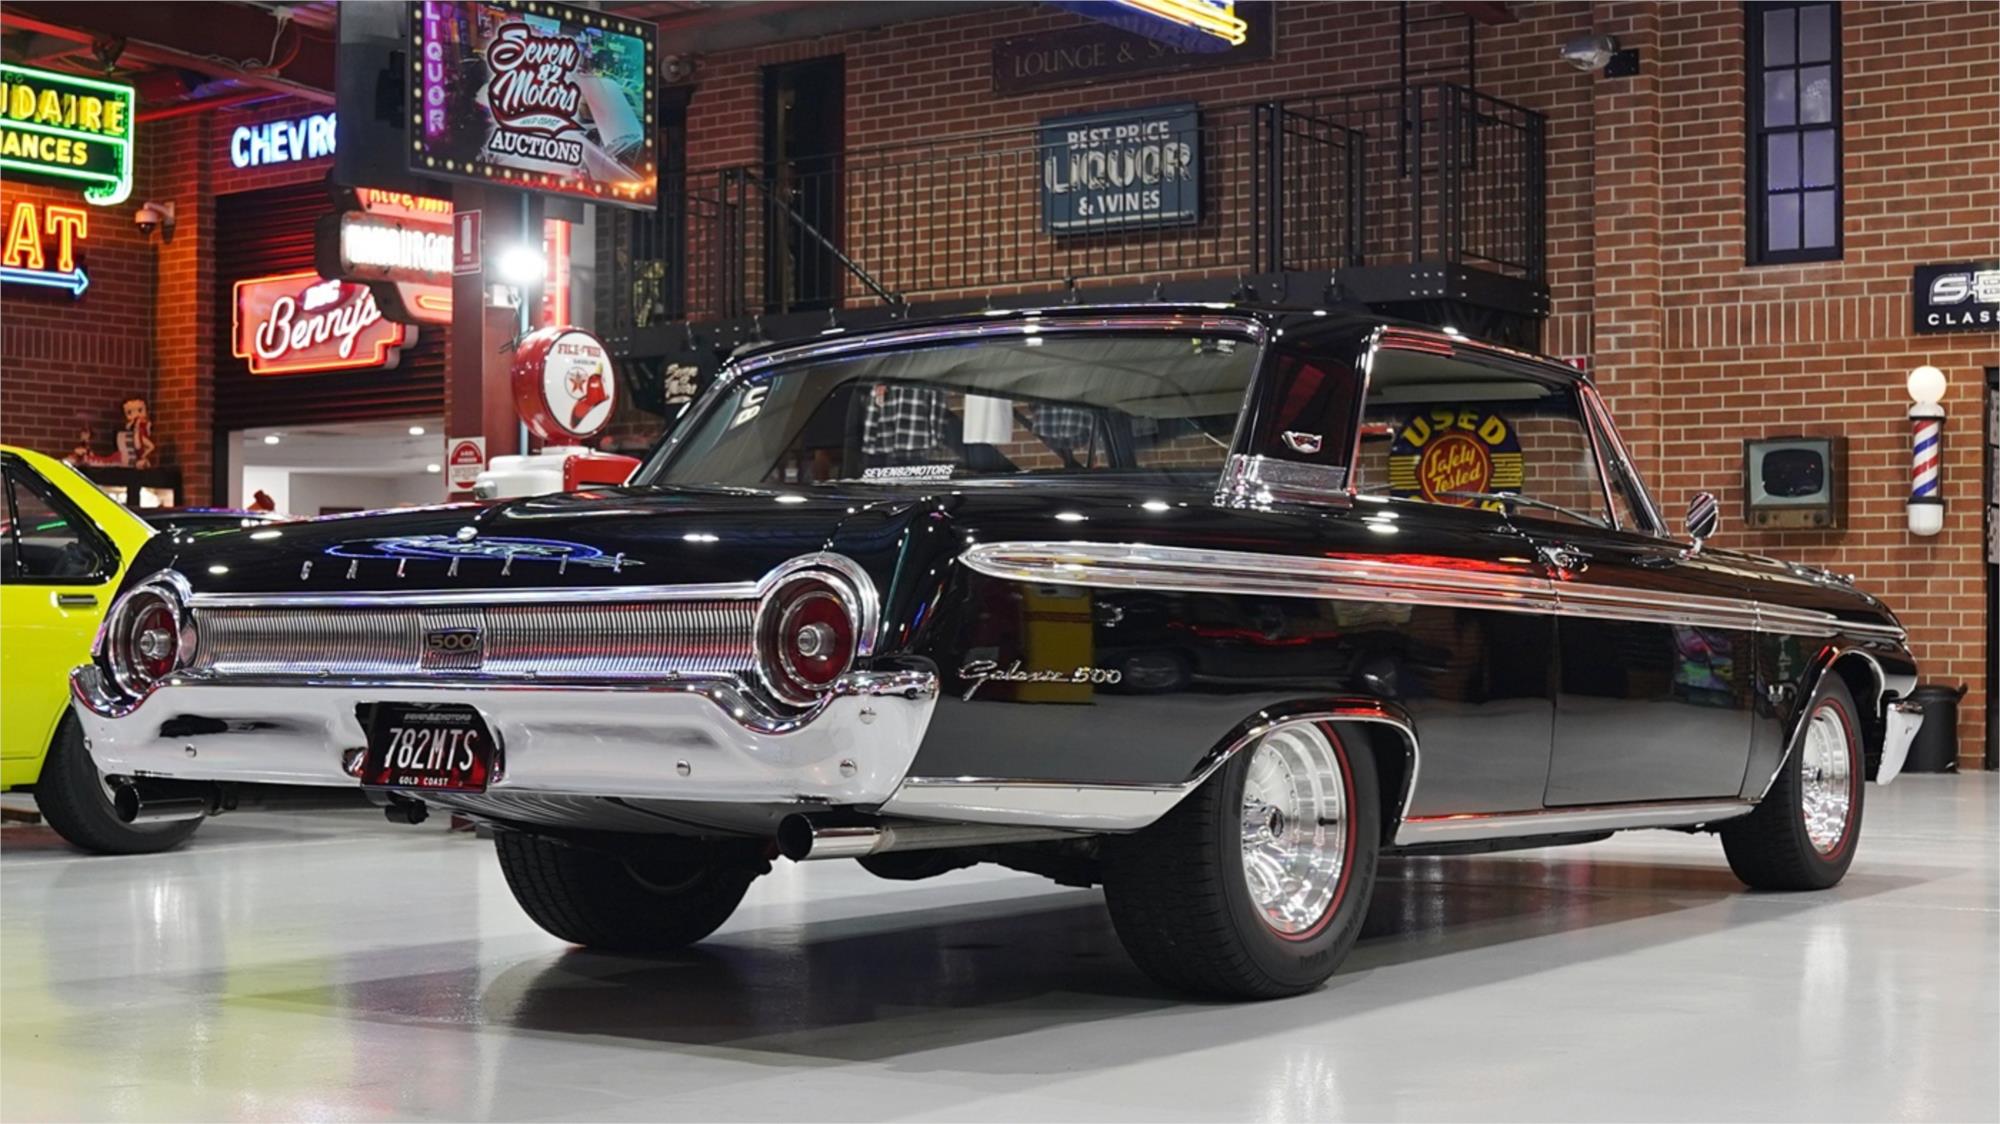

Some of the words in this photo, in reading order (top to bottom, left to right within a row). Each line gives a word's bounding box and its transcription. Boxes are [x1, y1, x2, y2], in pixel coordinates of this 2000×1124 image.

[426, 1, 445, 133] LIQUOR
[491, 29, 576, 71] Seven
[1014, 42, 1107, 78] LOUNGE
[1116, 41, 1135, 64] &
[493, 69, 577, 112] Motors
[538, 64, 562, 83] 82
[491, 131, 581, 163] AUCTIONS
[1067, 127, 1110, 149] BEST
[1116, 121, 1170, 145] PRICE
[1045, 142, 1192, 194] LIQUOR
[1078, 196, 1094, 216] &
[1097, 190, 1160, 214] WINES
[1402, 409, 1507, 448] USED
[1427, 443, 1477, 479] Safety
[1432, 461, 1482, 494] Tested
[300, 552, 625, 581] GALAXIE
[430, 634, 475, 650] 500
[958, 660, 1069, 701] Galaxie
[1071, 667, 1122, 684] 500
[384, 728, 478, 771] 782MTS
[398, 776, 418, 785] GOLD
[423, 777, 449, 786] COAST
